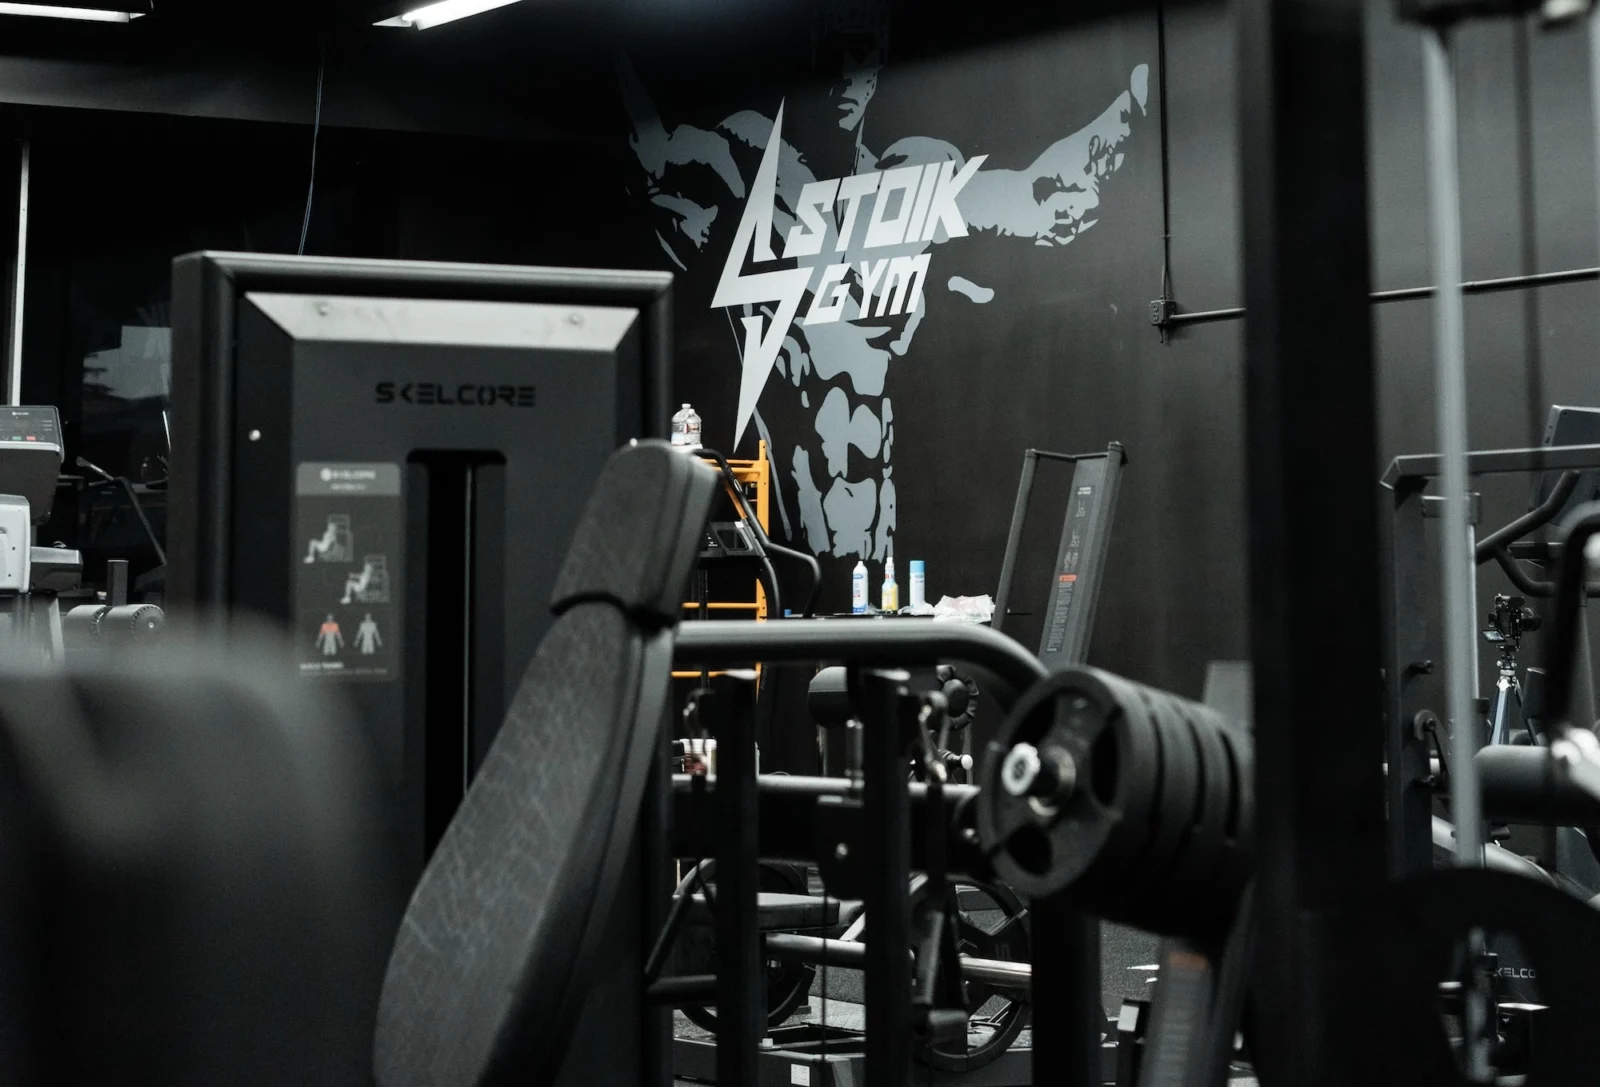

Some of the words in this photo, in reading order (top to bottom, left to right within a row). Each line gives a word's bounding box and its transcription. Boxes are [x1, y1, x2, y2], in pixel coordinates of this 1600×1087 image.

[782, 154, 990, 259] STOIK
[803, 253, 932, 326] GYM
[376, 382, 536, 407] SKELCORE
